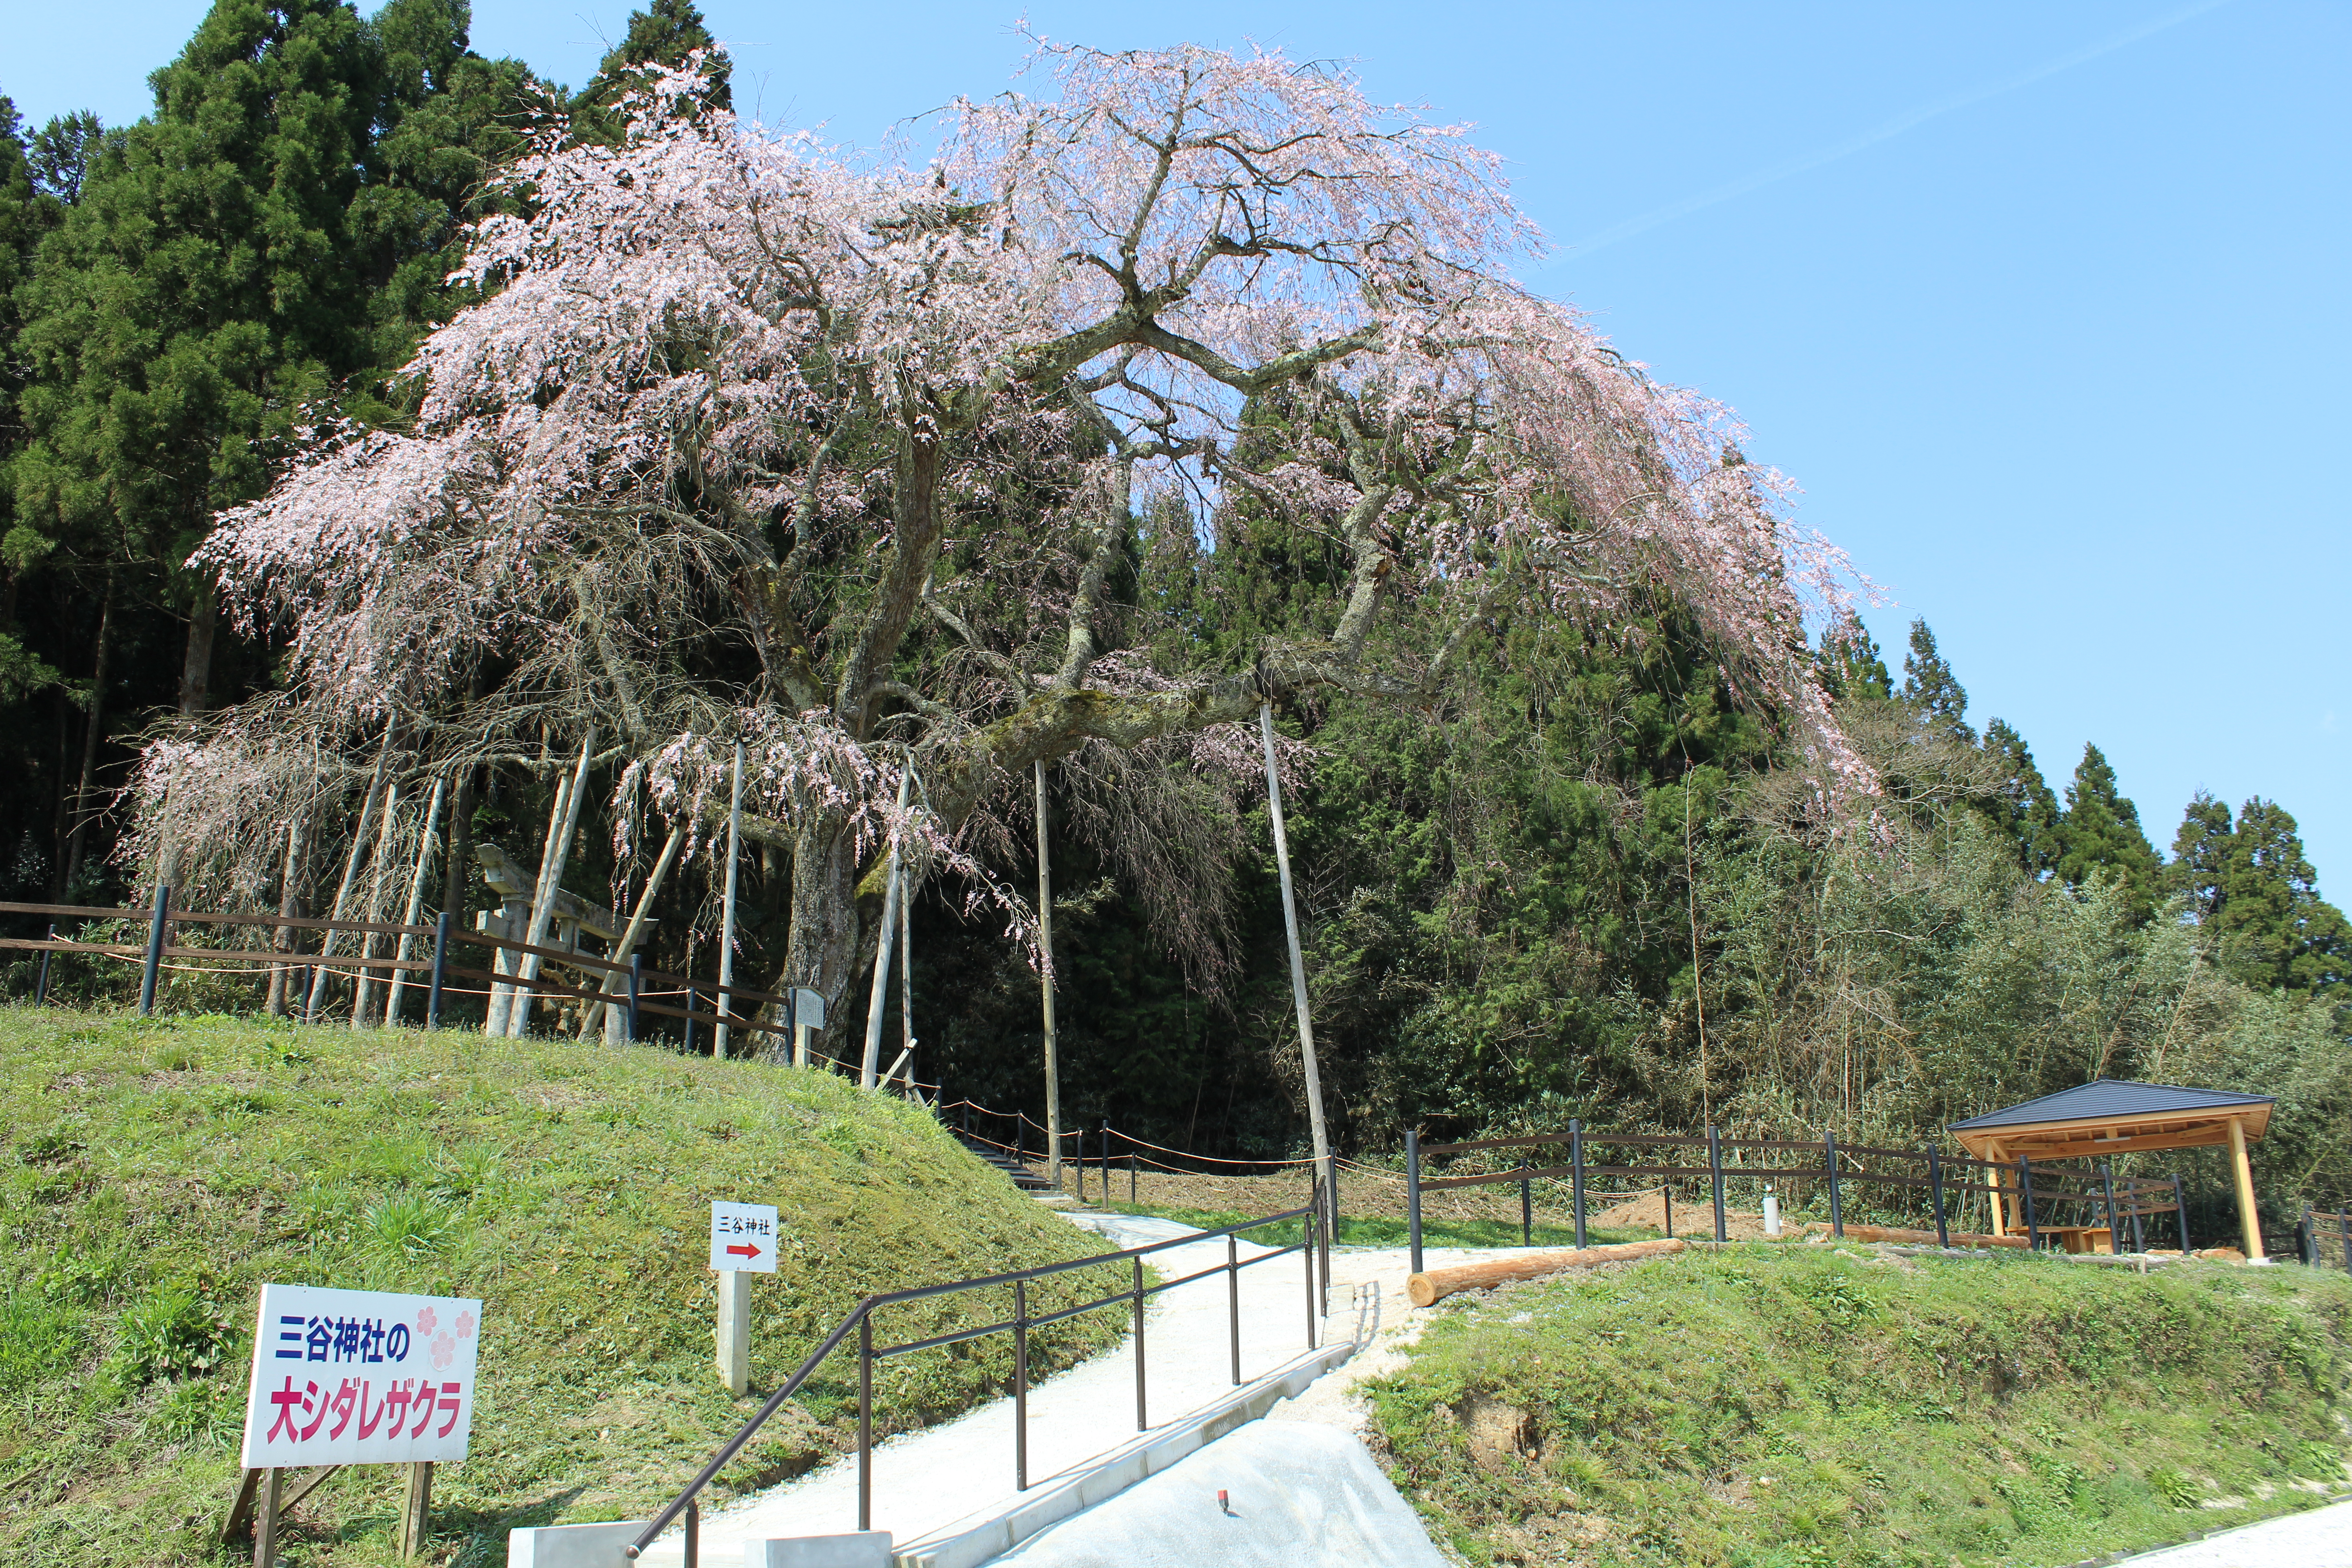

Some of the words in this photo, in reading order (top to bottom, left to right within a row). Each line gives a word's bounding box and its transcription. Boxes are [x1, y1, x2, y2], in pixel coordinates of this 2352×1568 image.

[718, 1216, 770, 1236] 三谷神社
[275, 1315, 410, 1363] 三谷神社の
[267, 1376, 461, 1444] 大シダレザクラ
